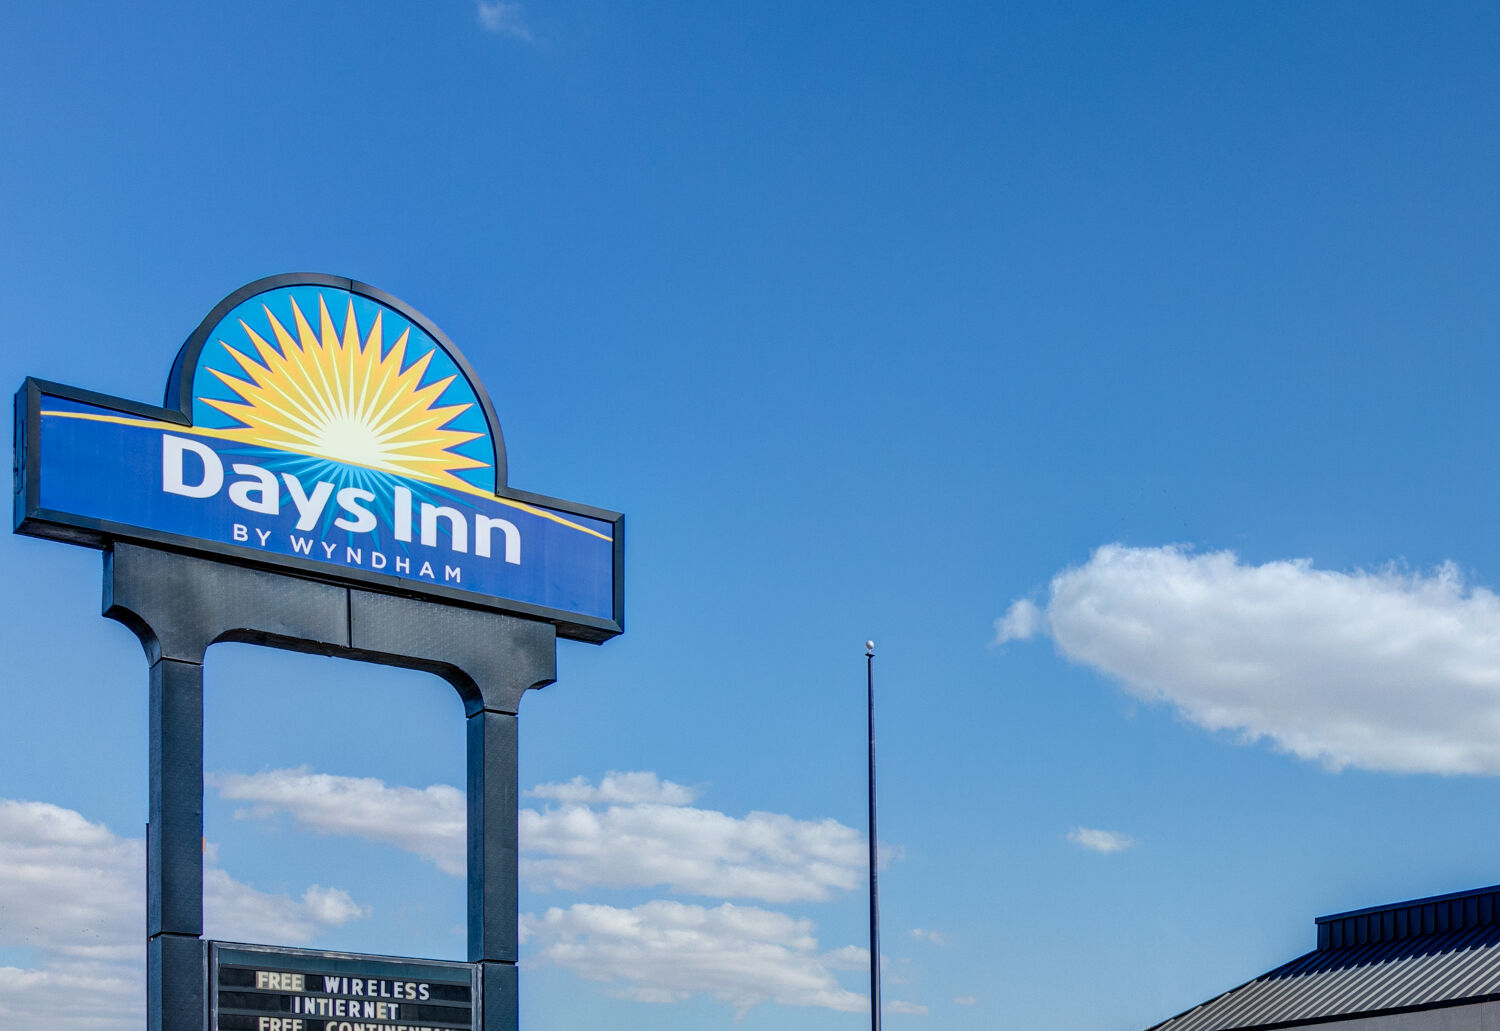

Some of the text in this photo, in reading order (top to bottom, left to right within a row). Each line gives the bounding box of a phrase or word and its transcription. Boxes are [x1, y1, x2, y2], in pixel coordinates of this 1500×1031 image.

[162, 433, 521, 565] Days Inn
[233, 523, 462, 583] BY WYNDHAM
[257, 971, 430, 1000] FREE WIRELESS
